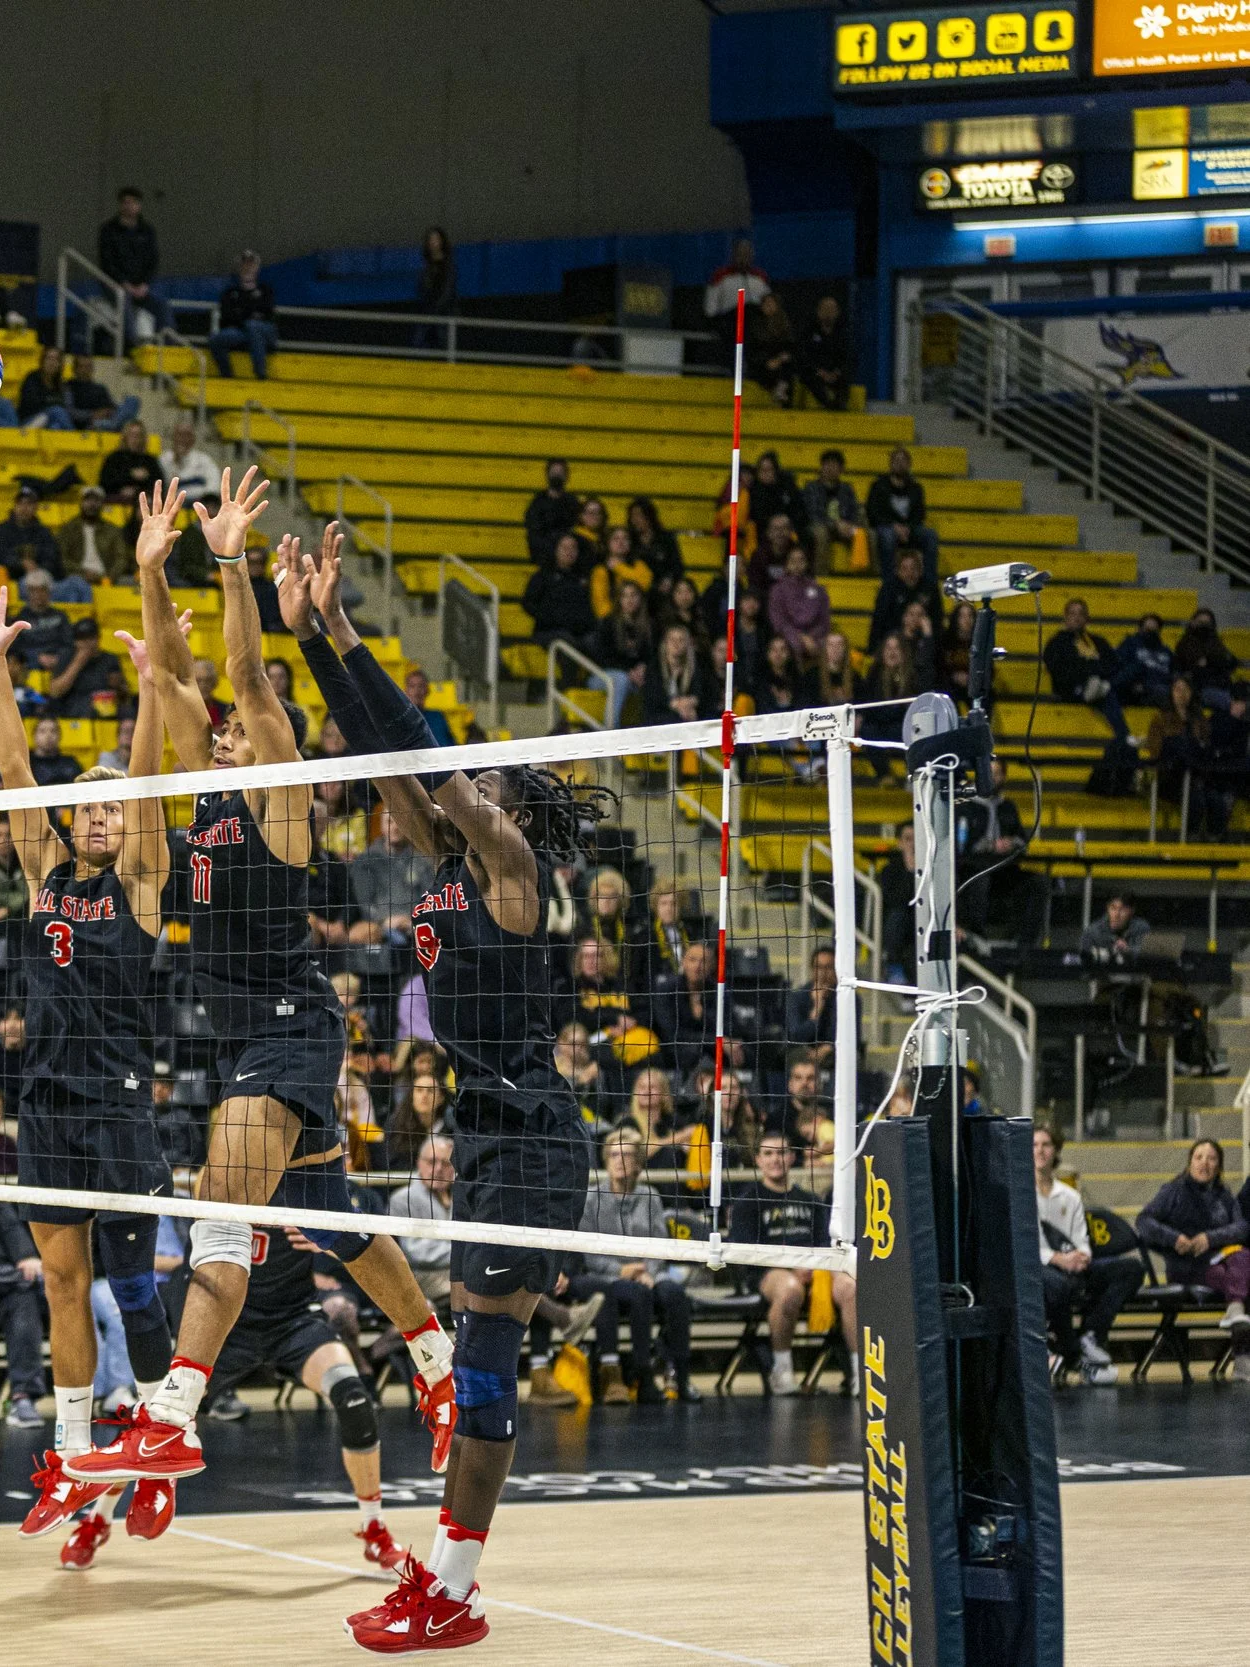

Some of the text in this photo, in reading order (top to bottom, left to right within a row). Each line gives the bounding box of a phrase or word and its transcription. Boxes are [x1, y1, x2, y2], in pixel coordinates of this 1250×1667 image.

[1177, 2, 1238, 23] Dignity
[838, 55, 1070, 85] FOLLOW US ON SOCIAL MEDIA
[962, 178, 1035, 199] TOYOTA
[814, 713, 835, 721] Senoh
[191, 852, 212, 904] 11
[60, 896, 116, 922] STATE
[44, 921, 73, 967] 3
[863, 1155, 895, 1261] LB
[863, 1326, 889, 1547] STATE
